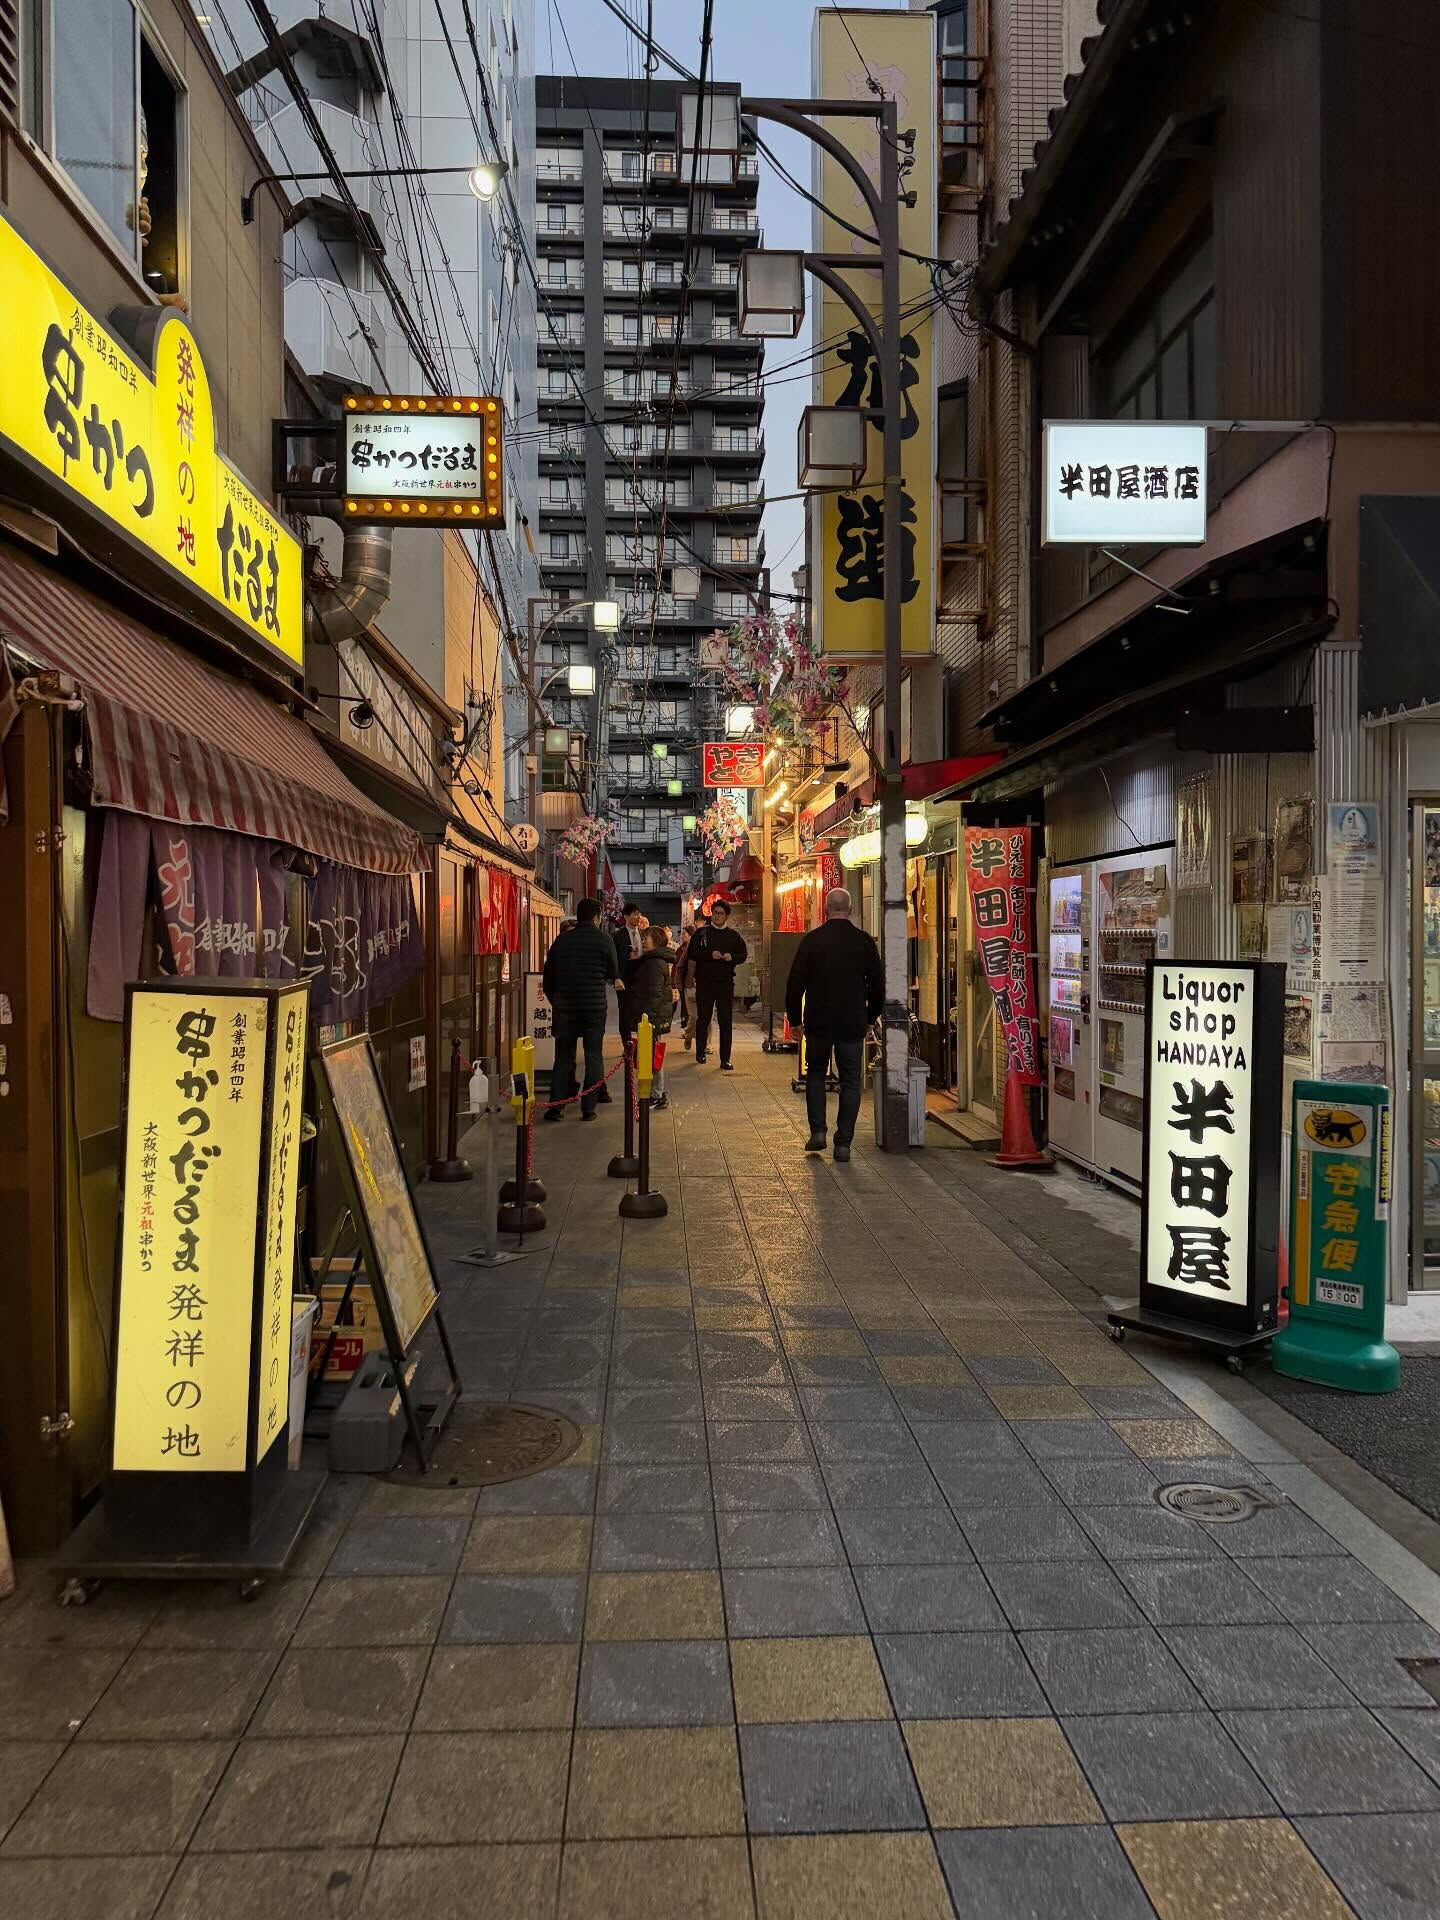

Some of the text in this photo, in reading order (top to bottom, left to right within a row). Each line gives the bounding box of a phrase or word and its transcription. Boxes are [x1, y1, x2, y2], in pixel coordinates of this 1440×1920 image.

[42, 323, 156, 519] 串かつ
[352, 423, 412, 435] 創業昭和四年
[176, 337, 197, 569] 発祥の地
[351, 439, 478, 473] 串かつだるま
[1059, 462, 1200, 501] 半田屋酒店
[216, 500, 280, 638] だるま
[708, 746, 761, 765] やき
[708, 765, 761, 783] とり
[1009, 835, 1024, 878] ひえた
[1011, 886, 1026, 942] 缶ビール
[1311, 889, 1322, 981] 内国勧業博覧会展
[1162, 972, 1246, 1007] Liquor
[1169, 1006, 1237, 1041] shop
[229, 1013, 248, 1104] 創業昭和四年
[1157, 1040, 1248, 1071] HANDAYA
[139, 1121, 159, 1273] 大阪新世界元祖串かつ
[1166, 1077, 1236, 1291] 半田屋
[1320, 1162, 1360, 1273] 宅急便
